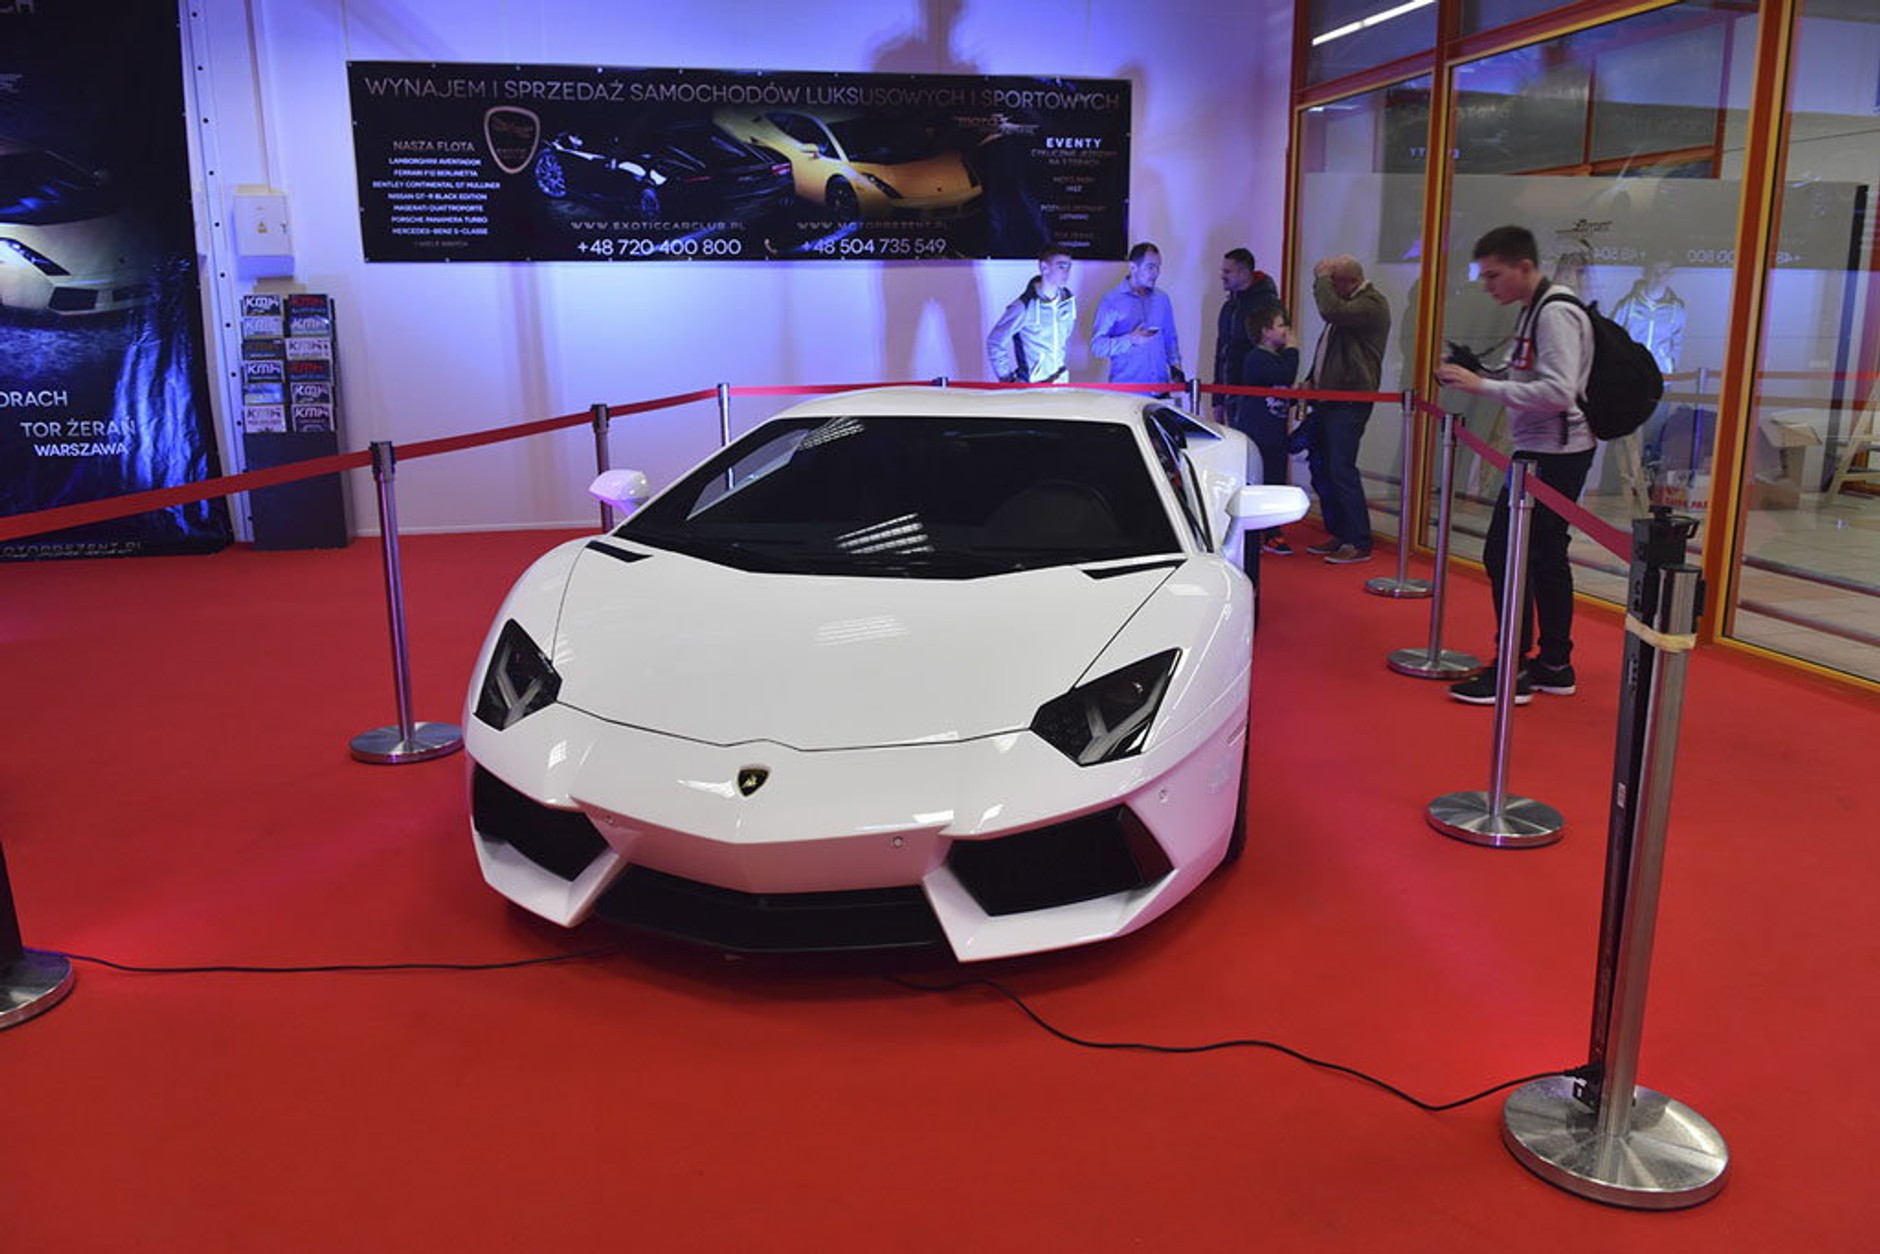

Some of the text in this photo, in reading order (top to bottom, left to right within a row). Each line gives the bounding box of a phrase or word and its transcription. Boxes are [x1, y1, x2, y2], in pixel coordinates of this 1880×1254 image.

[365, 77, 1121, 111] WYNAJEM I SPRZEDAŻ SAMOCHODÓW LUKSUSOWYCH I SPORTOWYCH
[392, 139, 475, 153] NASZA FLOTA
[1045, 137, 1103, 149] EVENTY
[392, 169, 424, 177] FERRARI
[371, 181, 405, 189] BENTLEY
[405, 181, 454, 189] CONTINENTAL
[387, 192, 415, 201] NISSAN
[435, 192, 458, 201] BLACK
[459, 192, 488, 201] EDITION
[390, 216, 424, 224] PORSCHE
[464, 216, 489, 224] TURBO
[391, 227, 453, 236] MERCEDES-BENZ
[571, 221, 746, 232] WWW.EXOTICCARCLUB.PL
[577, 239, 742, 256] +48 720 400 800
[800, 238, 947, 255] +48 504 735 549
[20, 416, 136, 438] TOR ŻERAŃ
[34, 442, 130, 457] WARSZAWA
